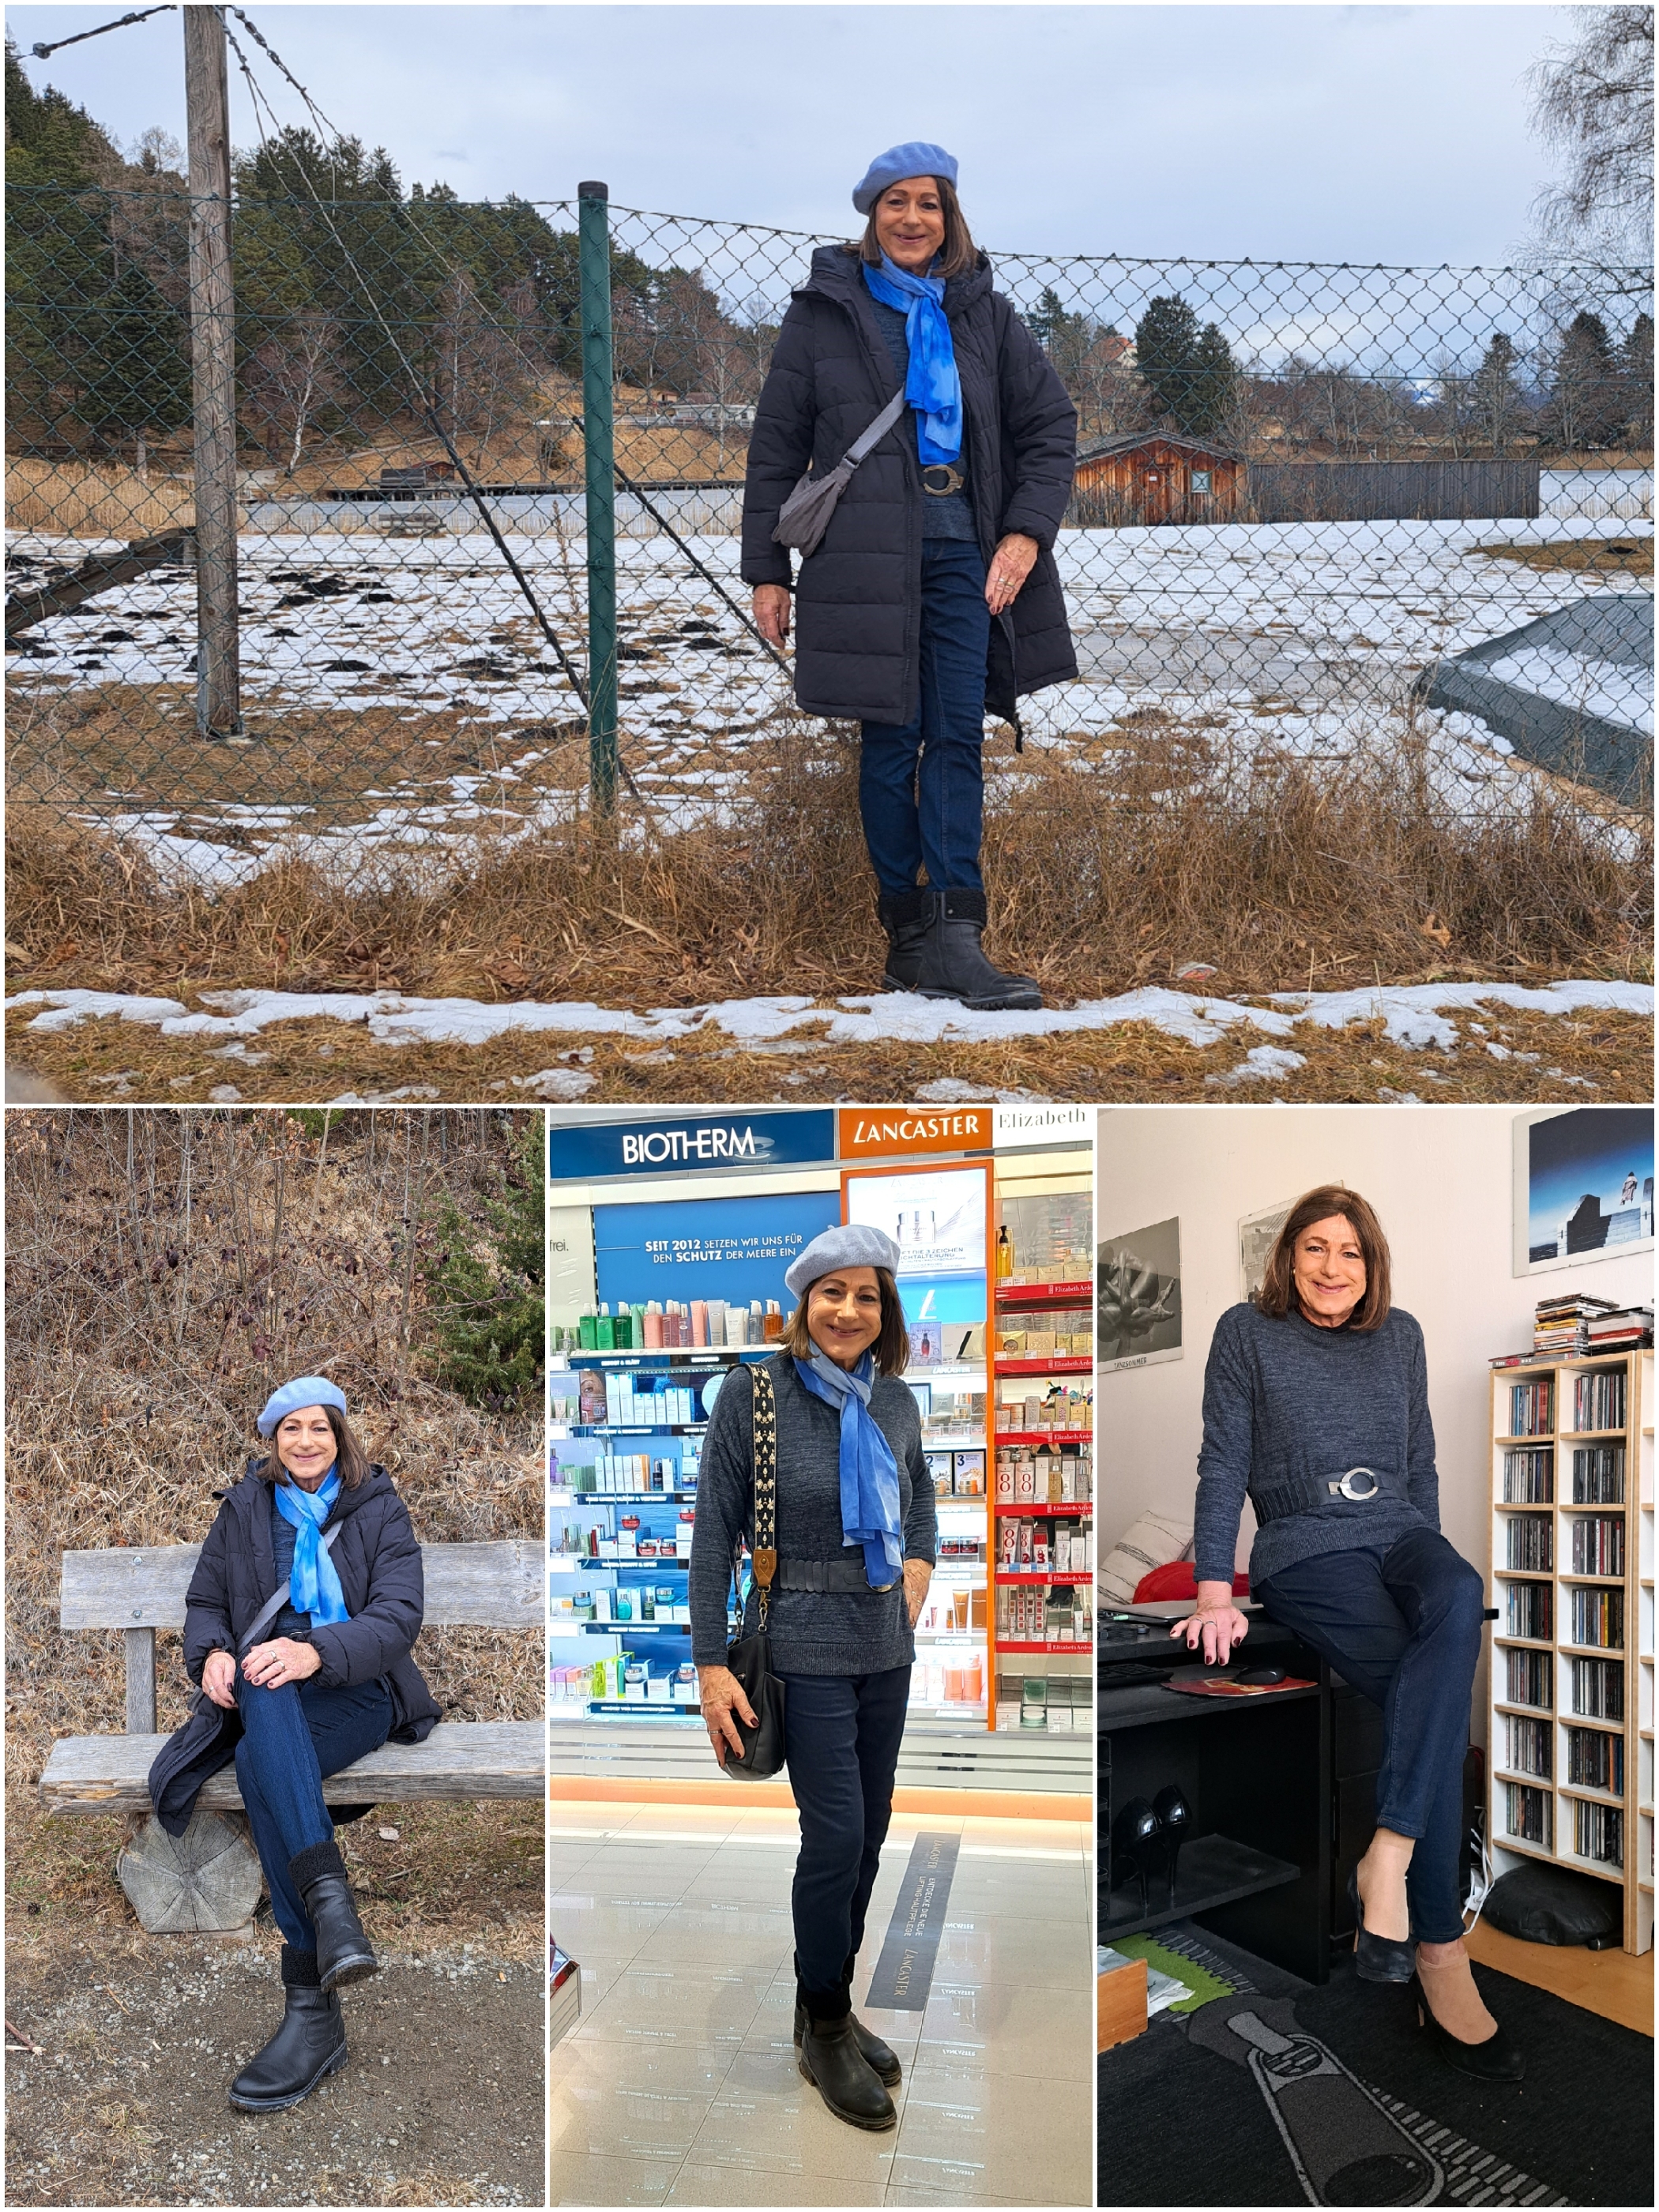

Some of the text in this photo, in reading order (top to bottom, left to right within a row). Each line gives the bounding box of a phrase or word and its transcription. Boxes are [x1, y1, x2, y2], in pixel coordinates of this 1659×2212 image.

[999, 1108, 1085, 1128] Elizabeth
[852, 1115, 979, 1144] LANCASTER
[623, 1126, 755, 1164] BIOTHERM
[645, 1233, 803, 1252] SEIT 2012 SETZEN WIR UNS FÜR
[653, 1247, 796, 1263] DEN SCHUTZ DER MEERE EIN
[1114, 1356, 1147, 1370] TANZSOMMER
[957, 1454, 965, 1466] 3
[999, 1473, 1010, 1492] 8
[1021, 1473, 1032, 1492] 8
[1004, 1529, 1014, 1548] 8
[1021, 1533, 1027, 1548] 8
[1005, 1553, 1011, 1563] 1
[1021, 1553, 1030, 1563] 2
[1037, 1553, 1045, 1563] 3
[927, 1839, 946, 1869] LANCASTER
[903, 1875, 926, 1937] LIFTING HAUTPFLEGE
[915, 1877, 936, 1936] ENTDECKE DIE NEUE
[893, 1949, 919, 1996] LANCASTER
